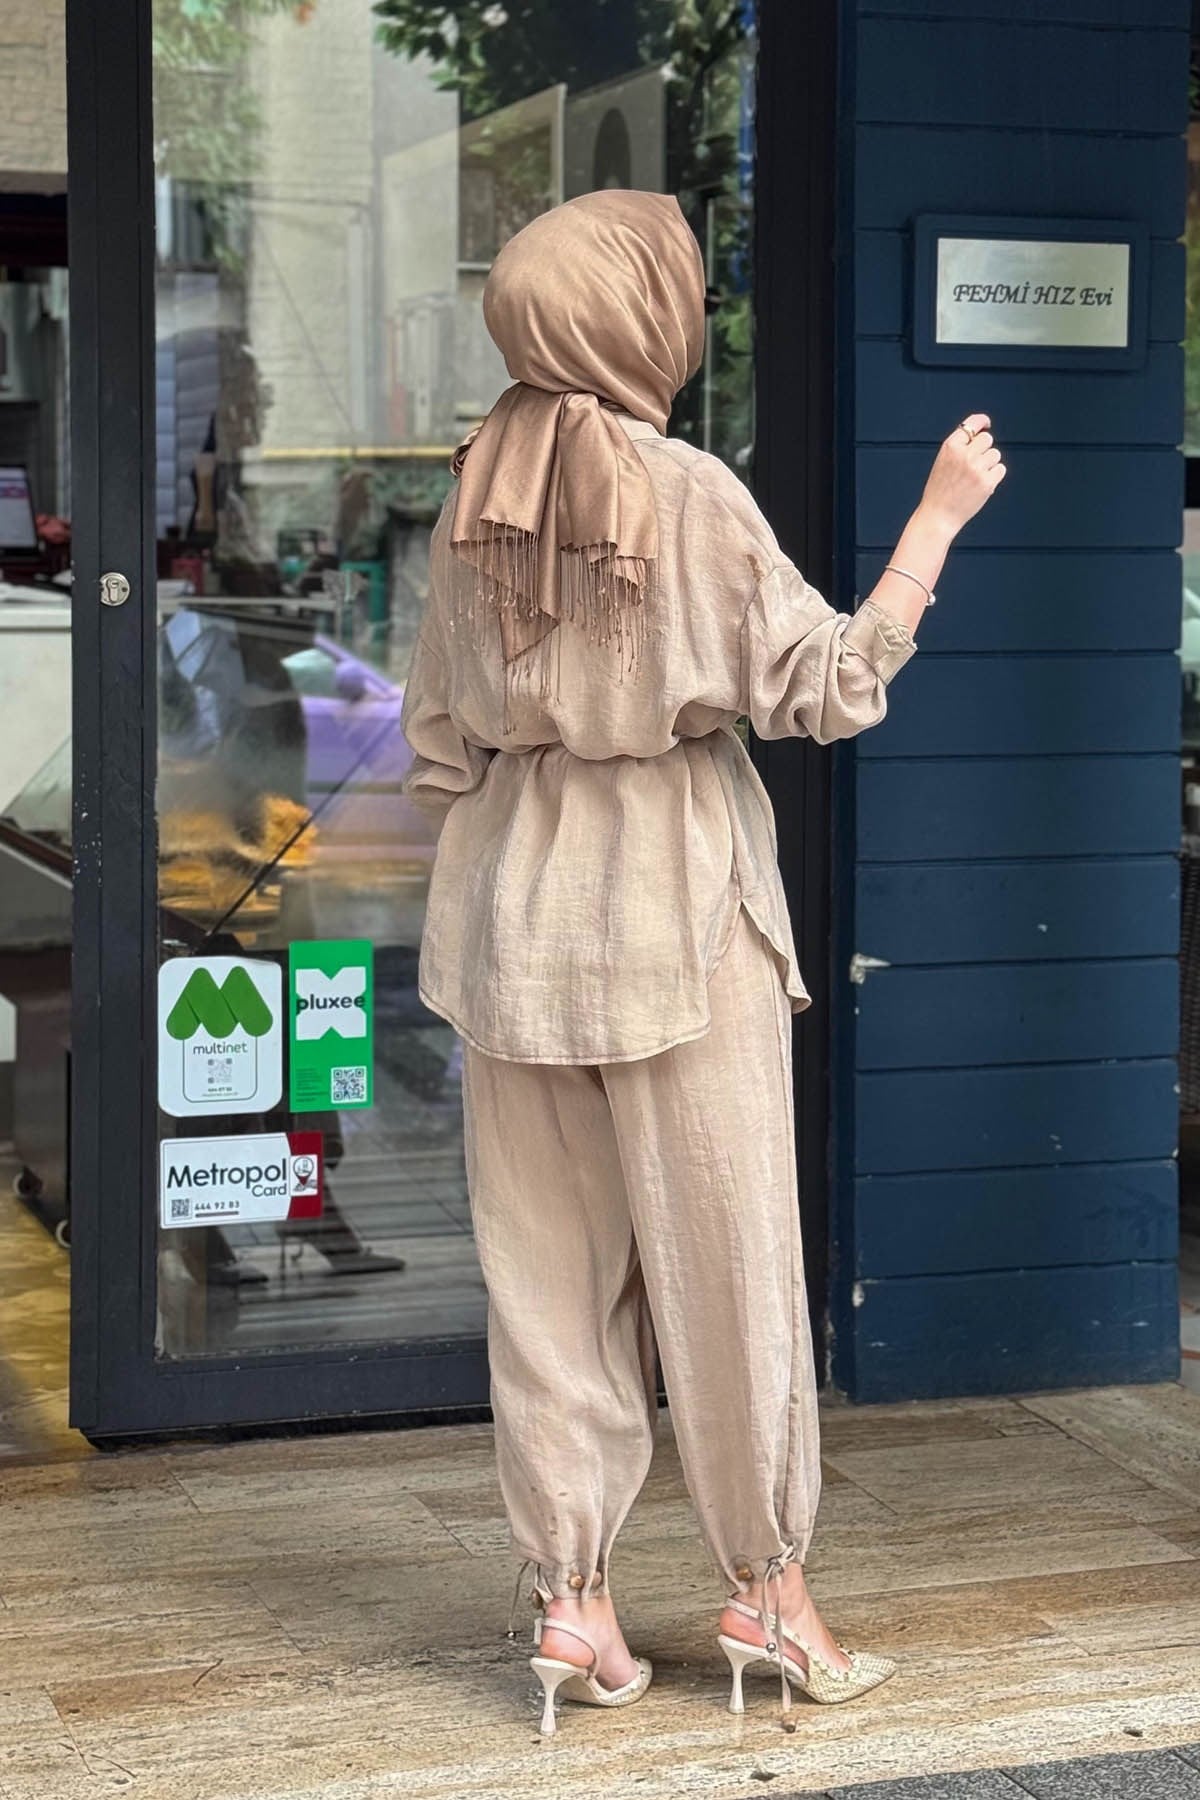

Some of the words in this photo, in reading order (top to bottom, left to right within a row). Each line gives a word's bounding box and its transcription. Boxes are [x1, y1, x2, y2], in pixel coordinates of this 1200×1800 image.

[953, 281, 1030, 304] FEHMİ
[1032, 285, 1076, 305] HIZ
[1079, 287, 1114, 306] Evi
[296, 993, 367, 1016] pluxee
[192, 1042, 248, 1055] multinet
[167, 1158, 287, 1189] Metropol
[251, 1183, 287, 1198] Card
